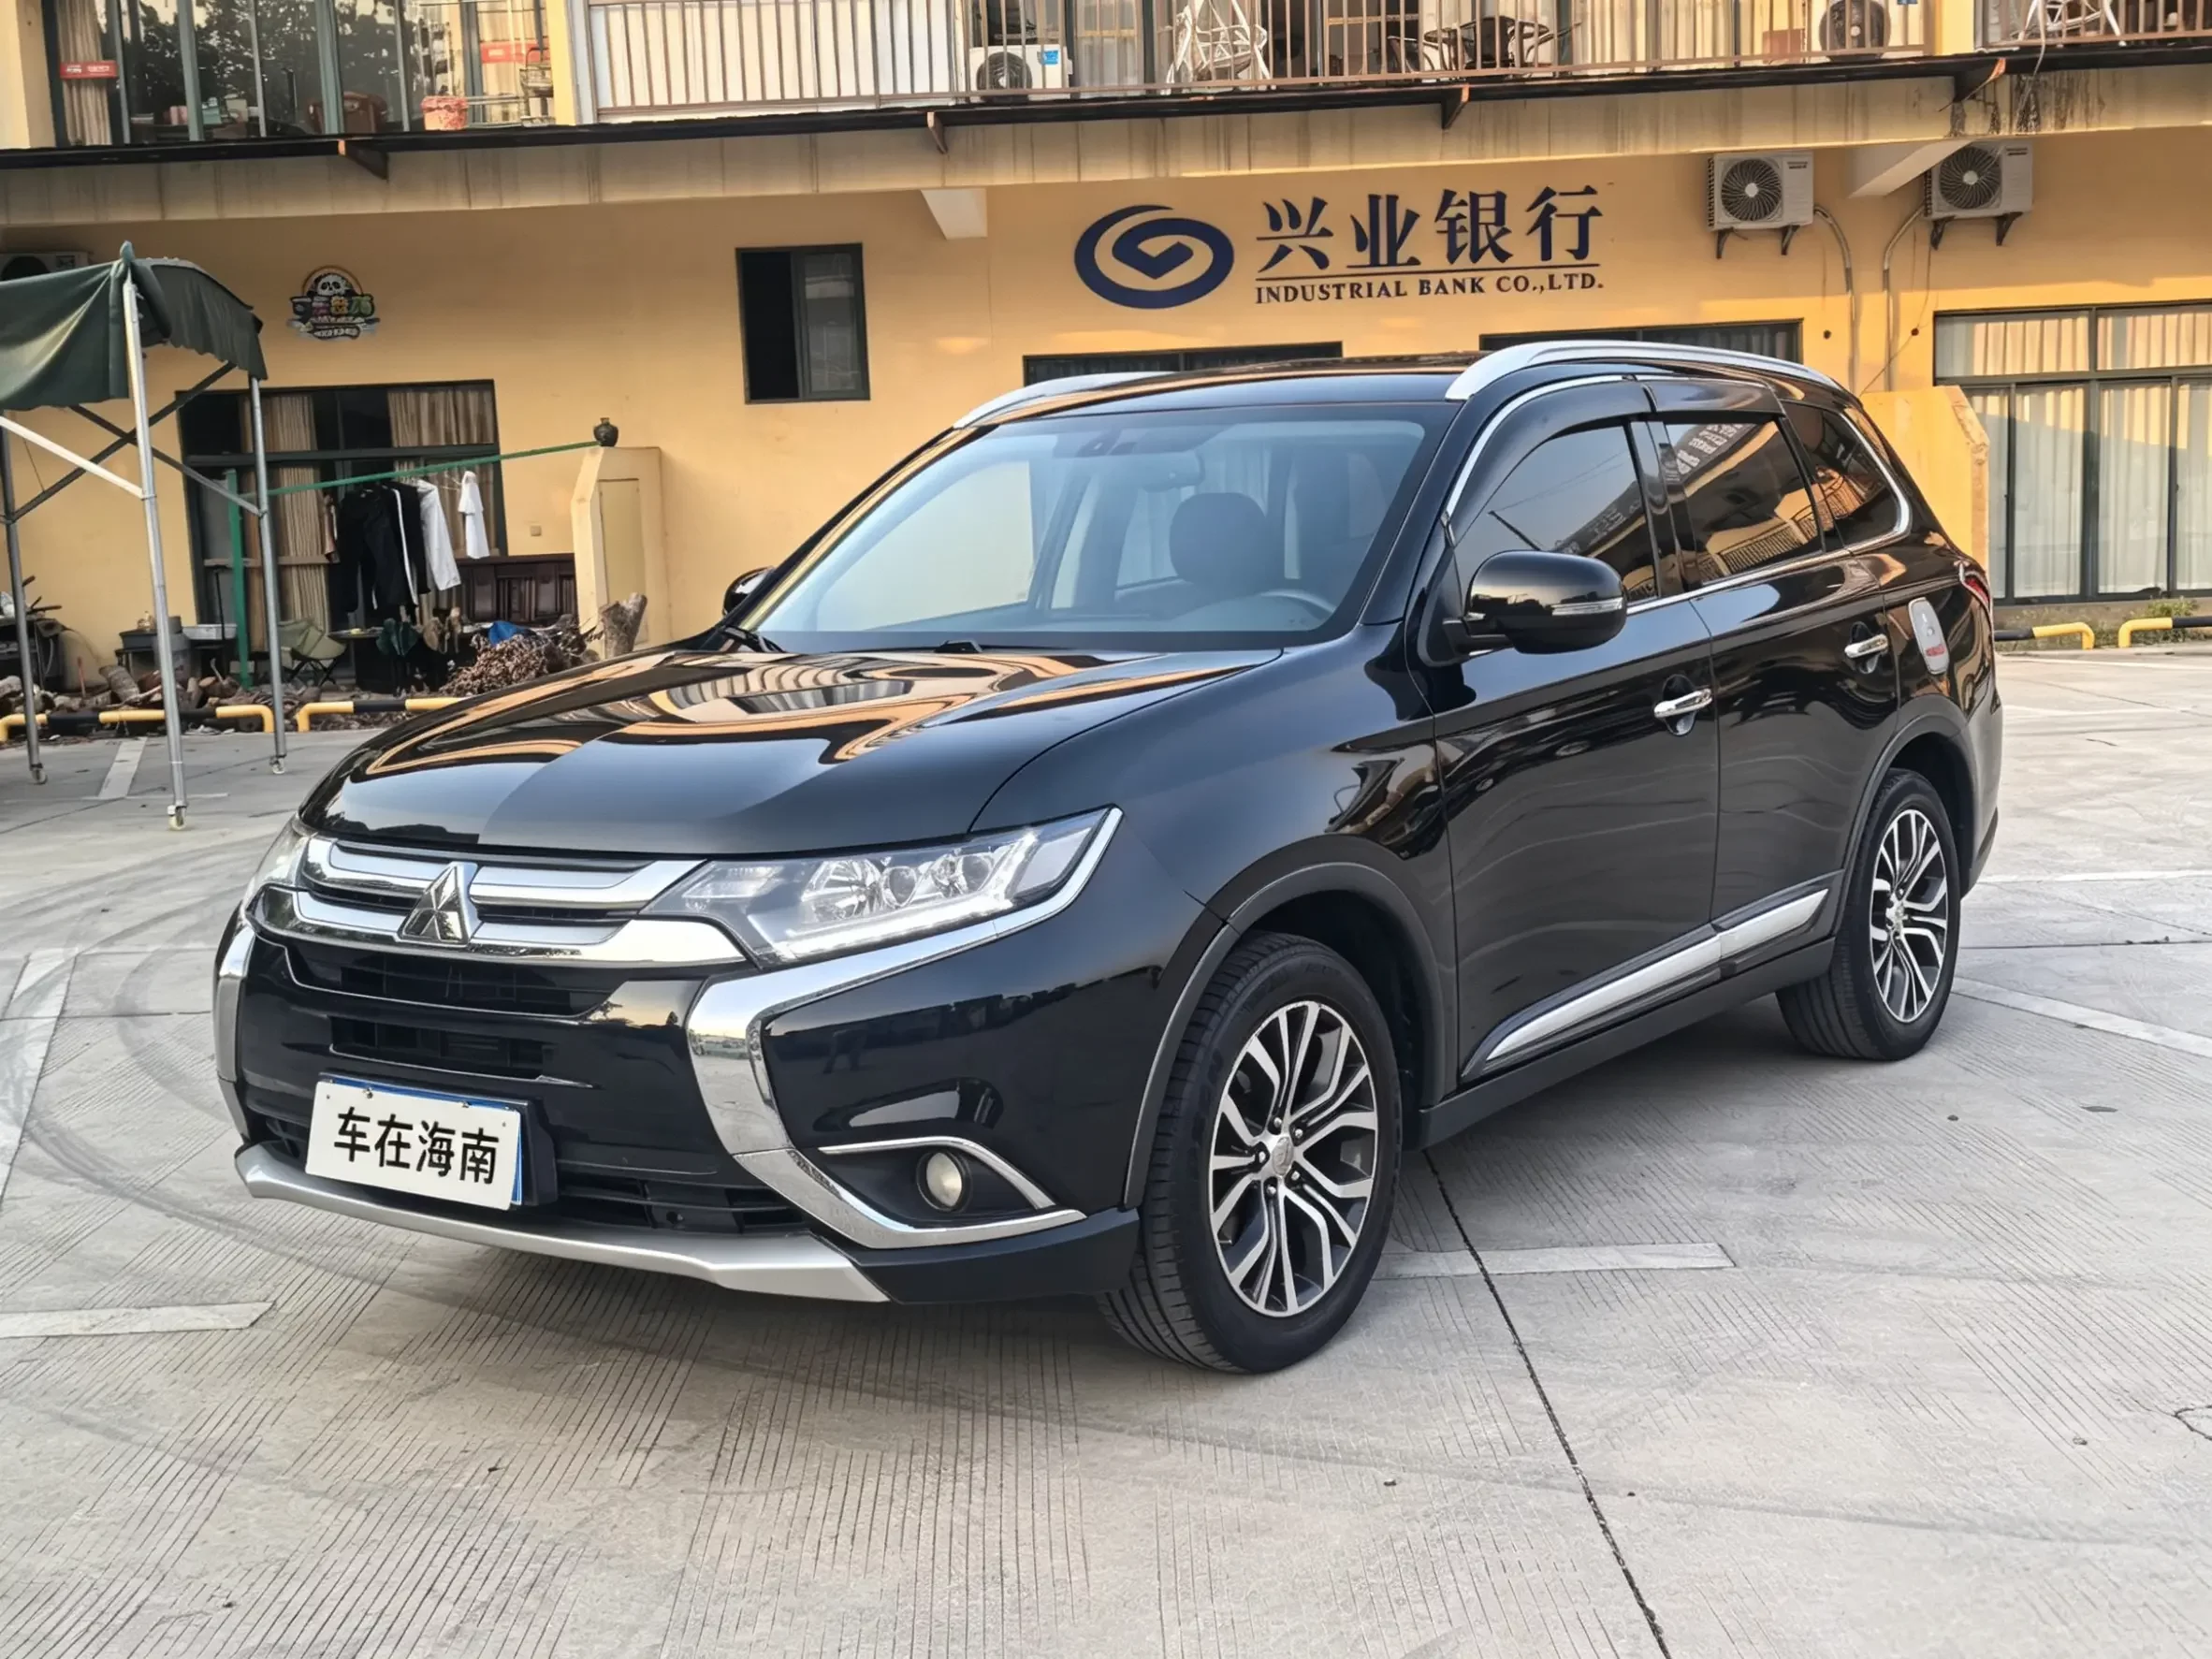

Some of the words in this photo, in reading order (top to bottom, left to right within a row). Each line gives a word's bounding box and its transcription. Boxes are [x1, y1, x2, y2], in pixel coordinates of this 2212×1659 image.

[1256, 185, 1603, 273] 兴业银行
[1256, 280, 1408, 304] INDUSTRIAL
[1419, 275, 1486, 296] BANK
[334, 1106, 500, 1185] 车在海南
